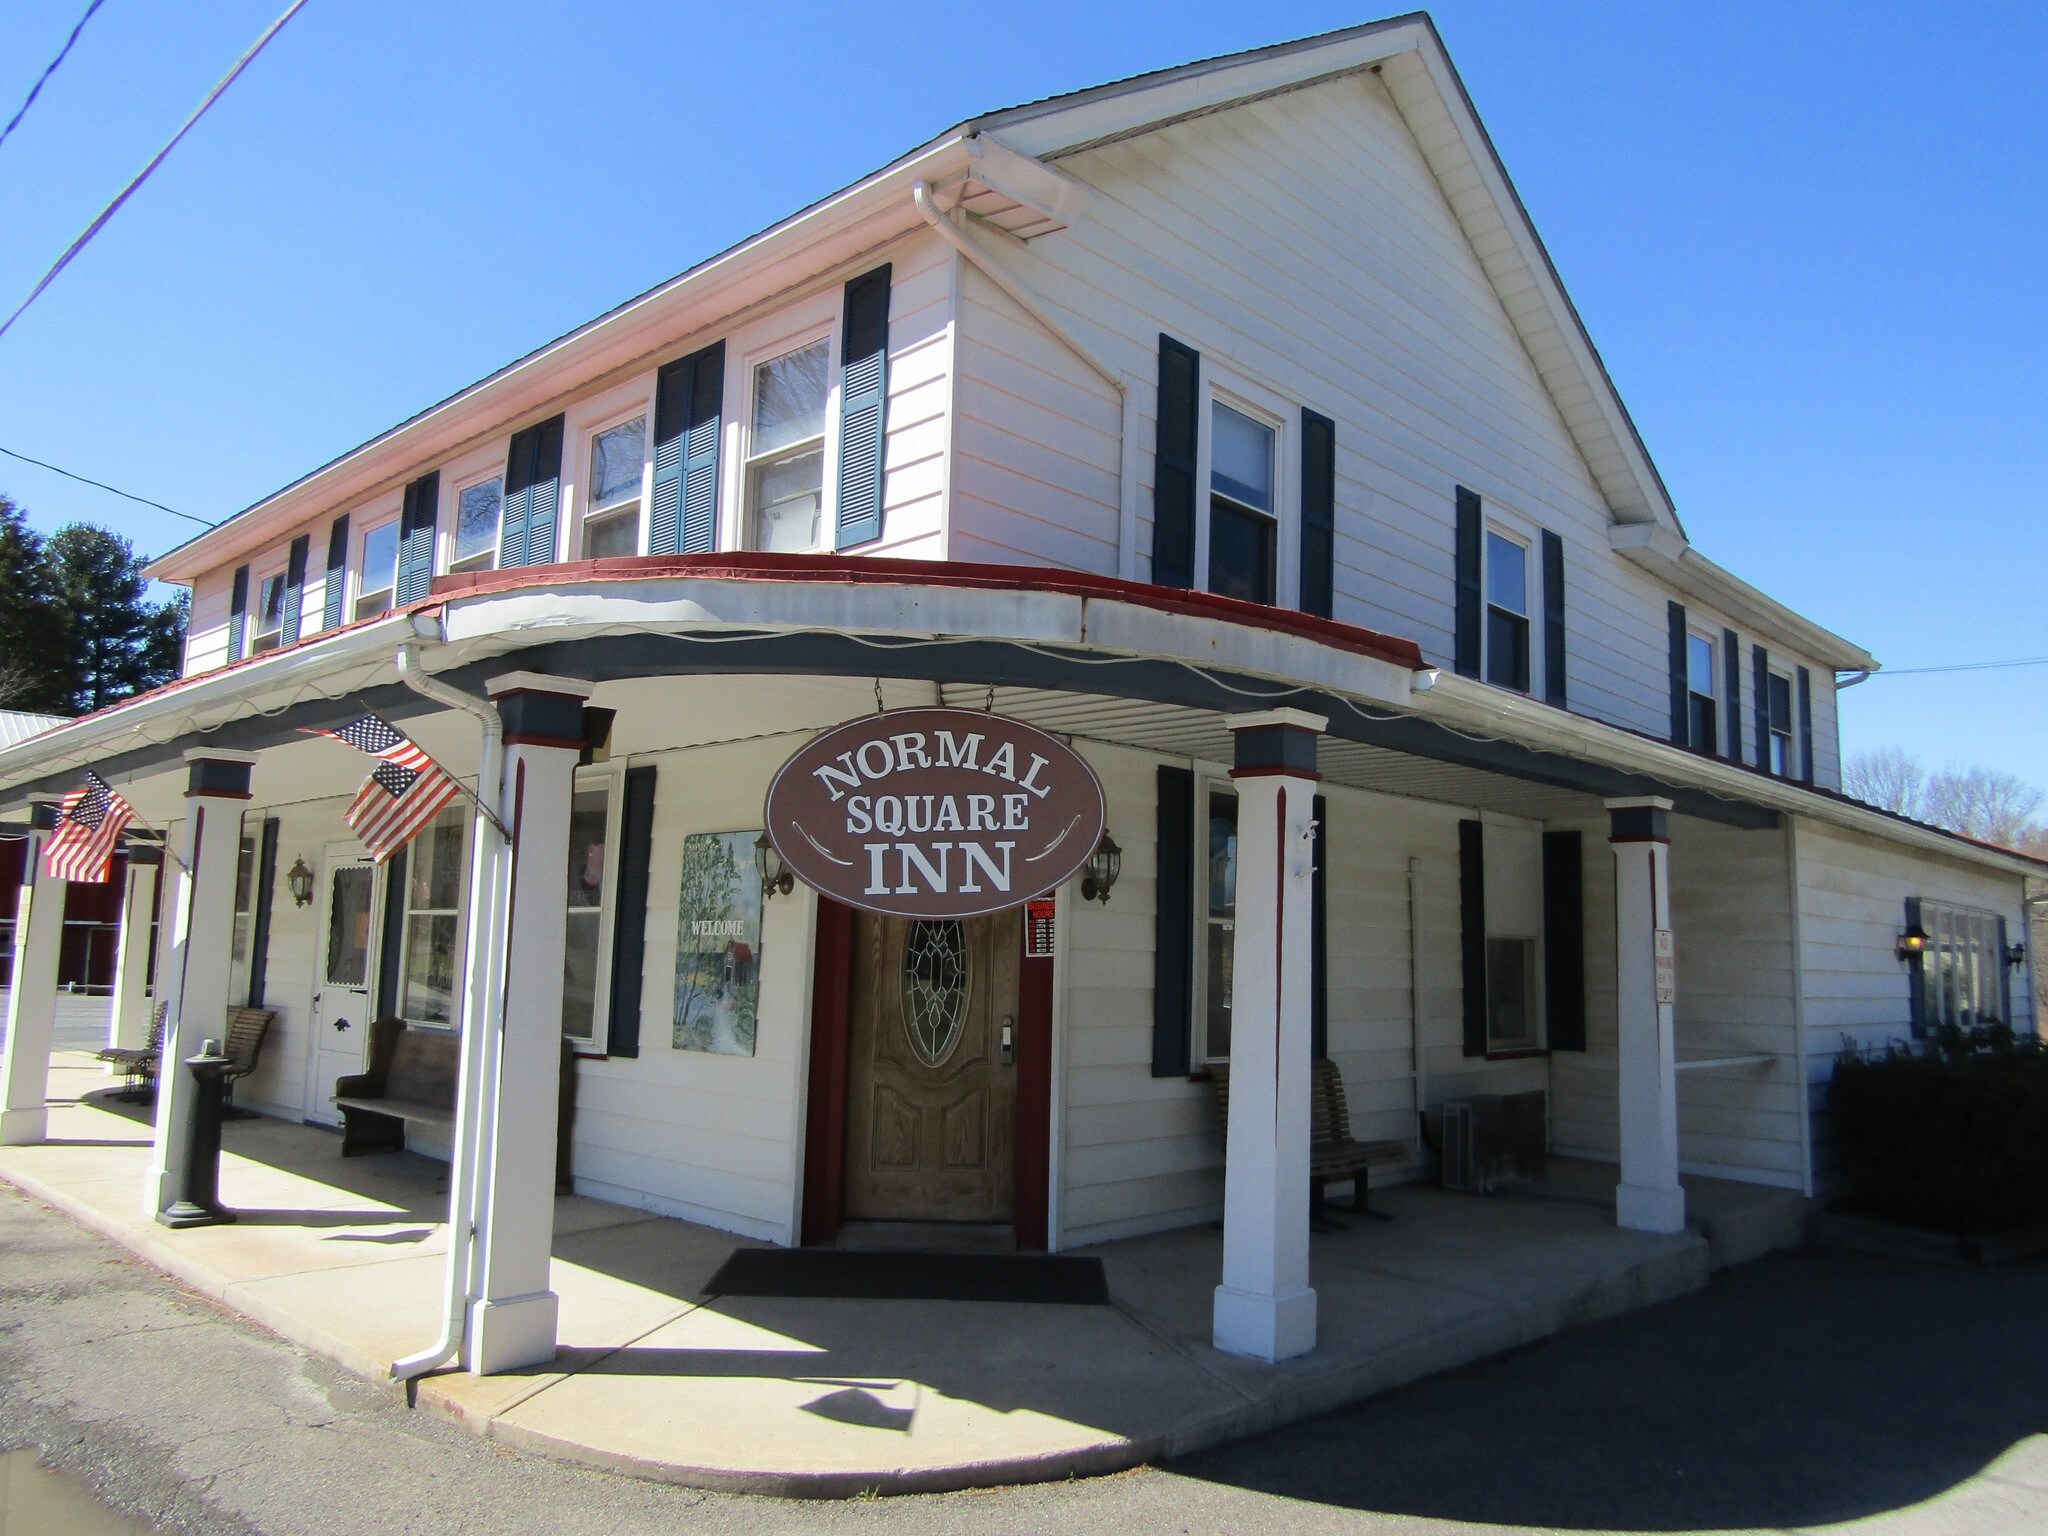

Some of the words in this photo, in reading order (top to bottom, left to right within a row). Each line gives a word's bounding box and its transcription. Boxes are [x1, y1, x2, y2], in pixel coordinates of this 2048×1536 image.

[812, 730, 1051, 802] NORMAL
[846, 793, 1029, 837] SQUARE
[864, 841, 1016, 895] INN
[1028, 901, 1055, 910] BUSINES
[1033, 910, 1054, 918] HOURS
[691, 920, 744, 936] WELCOME
